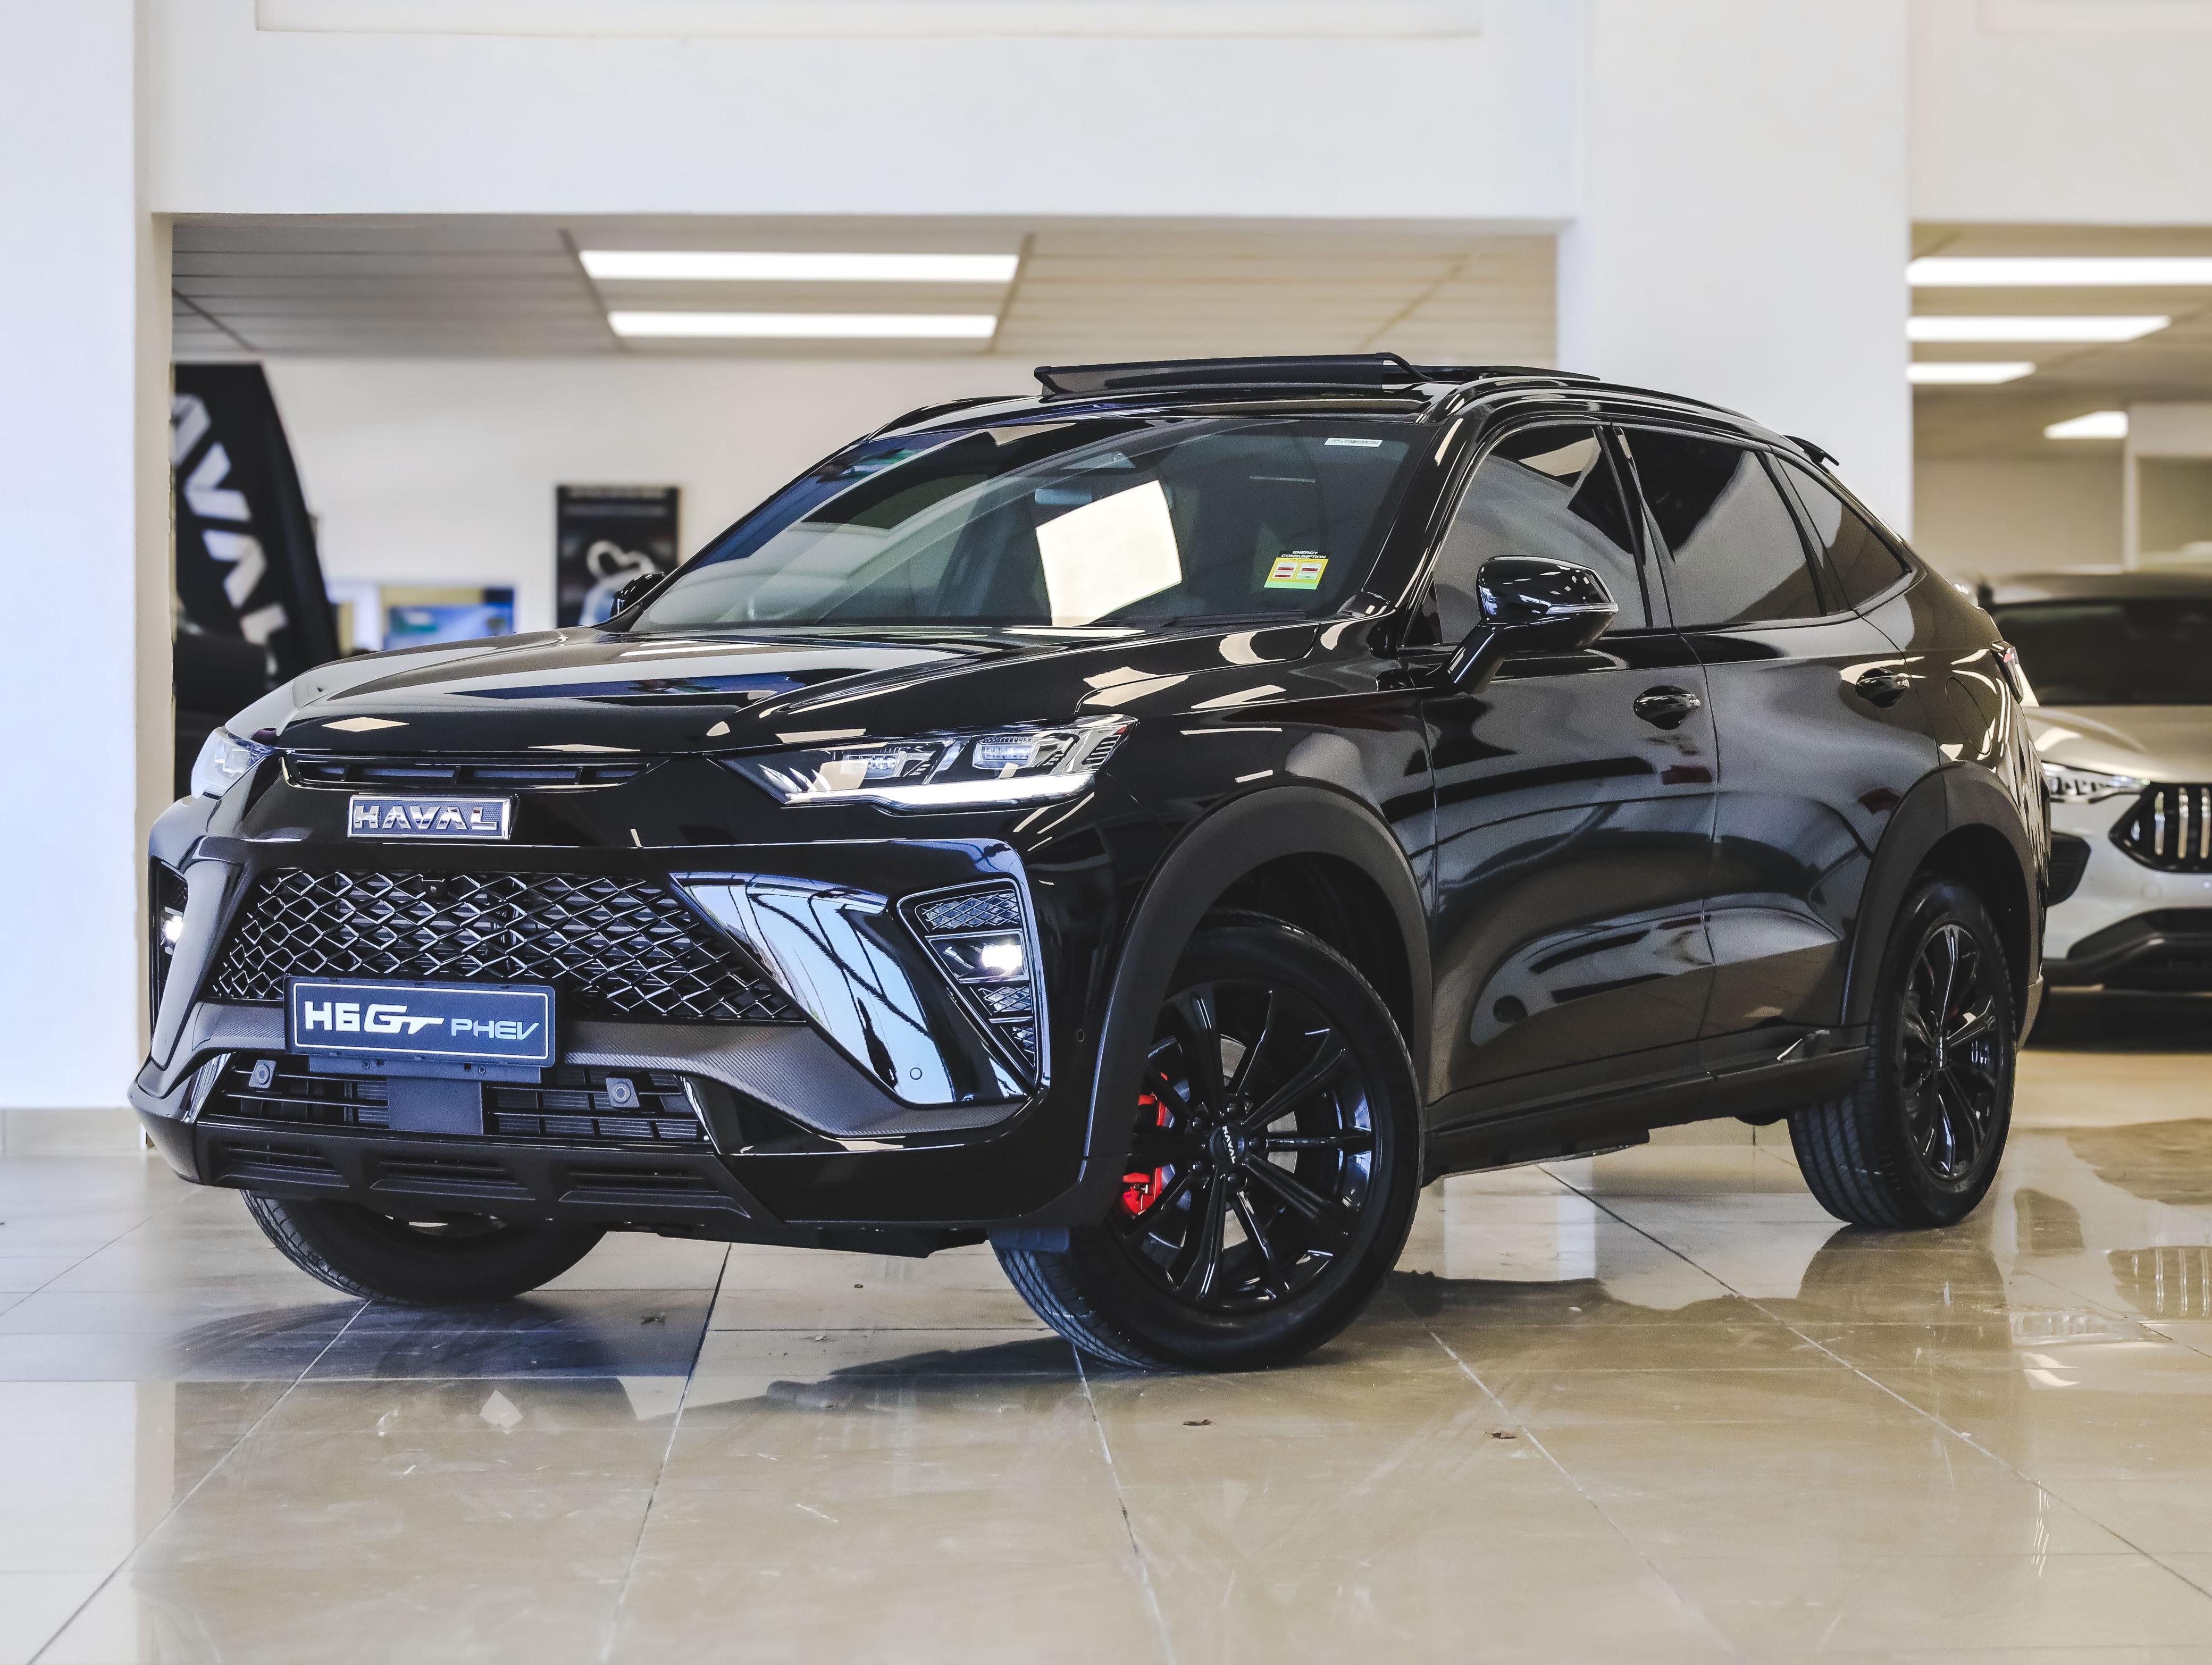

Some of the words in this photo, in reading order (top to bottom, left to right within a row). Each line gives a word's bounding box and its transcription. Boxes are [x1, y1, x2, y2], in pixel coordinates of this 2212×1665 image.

[171, 393, 288, 674] AVAL
[355, 805, 497, 830] HAVAL
[451, 1018, 539, 1040] PHEV
